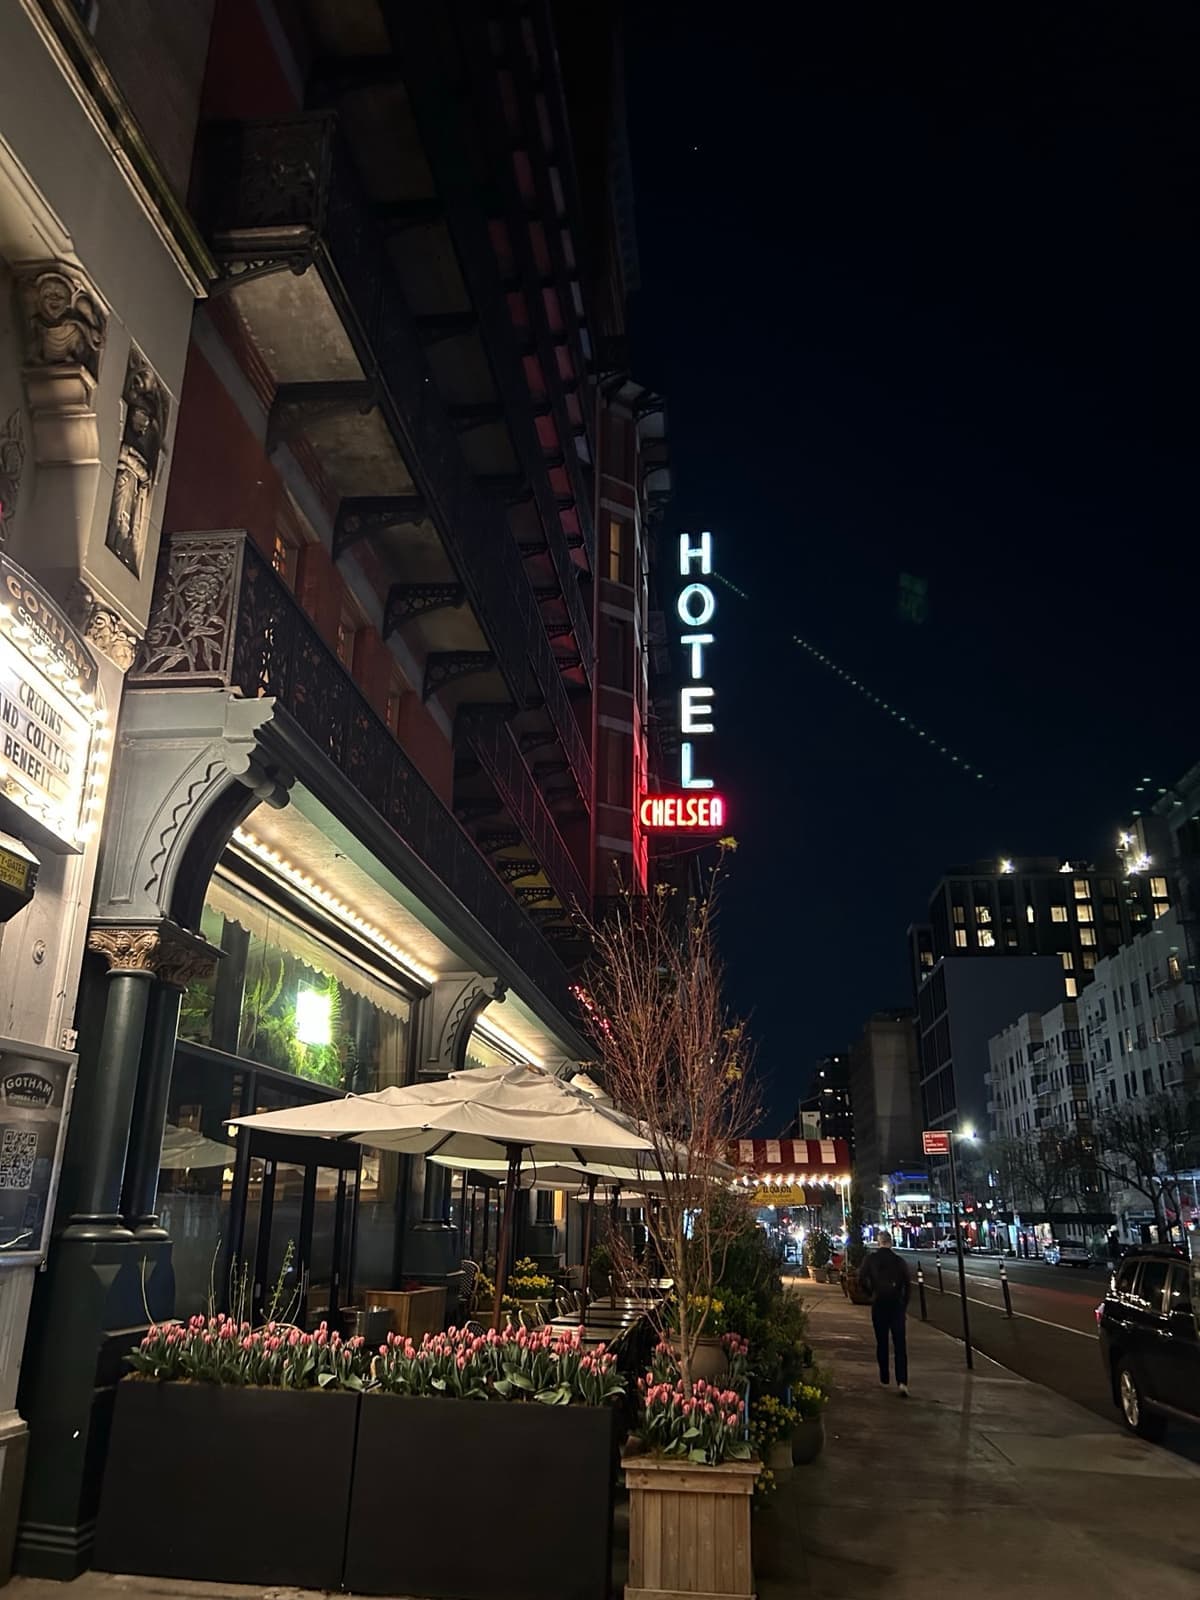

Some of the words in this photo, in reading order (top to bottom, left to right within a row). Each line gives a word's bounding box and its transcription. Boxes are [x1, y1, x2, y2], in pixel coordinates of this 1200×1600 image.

[6, 575, 92, 680] GOTHAM
[18, 606, 56, 650] COMEDY
[56, 648, 80, 677] CLUB
[677, 531, 715, 789] HOTEL
[0, 692, 19, 730] ND
[26, 721, 70, 776] COLITIS
[3, 733, 54, 793] BENEFIT
[640, 797, 724, 827] CHELSEA
[6, 1076, 52, 1097] GOTHAM
